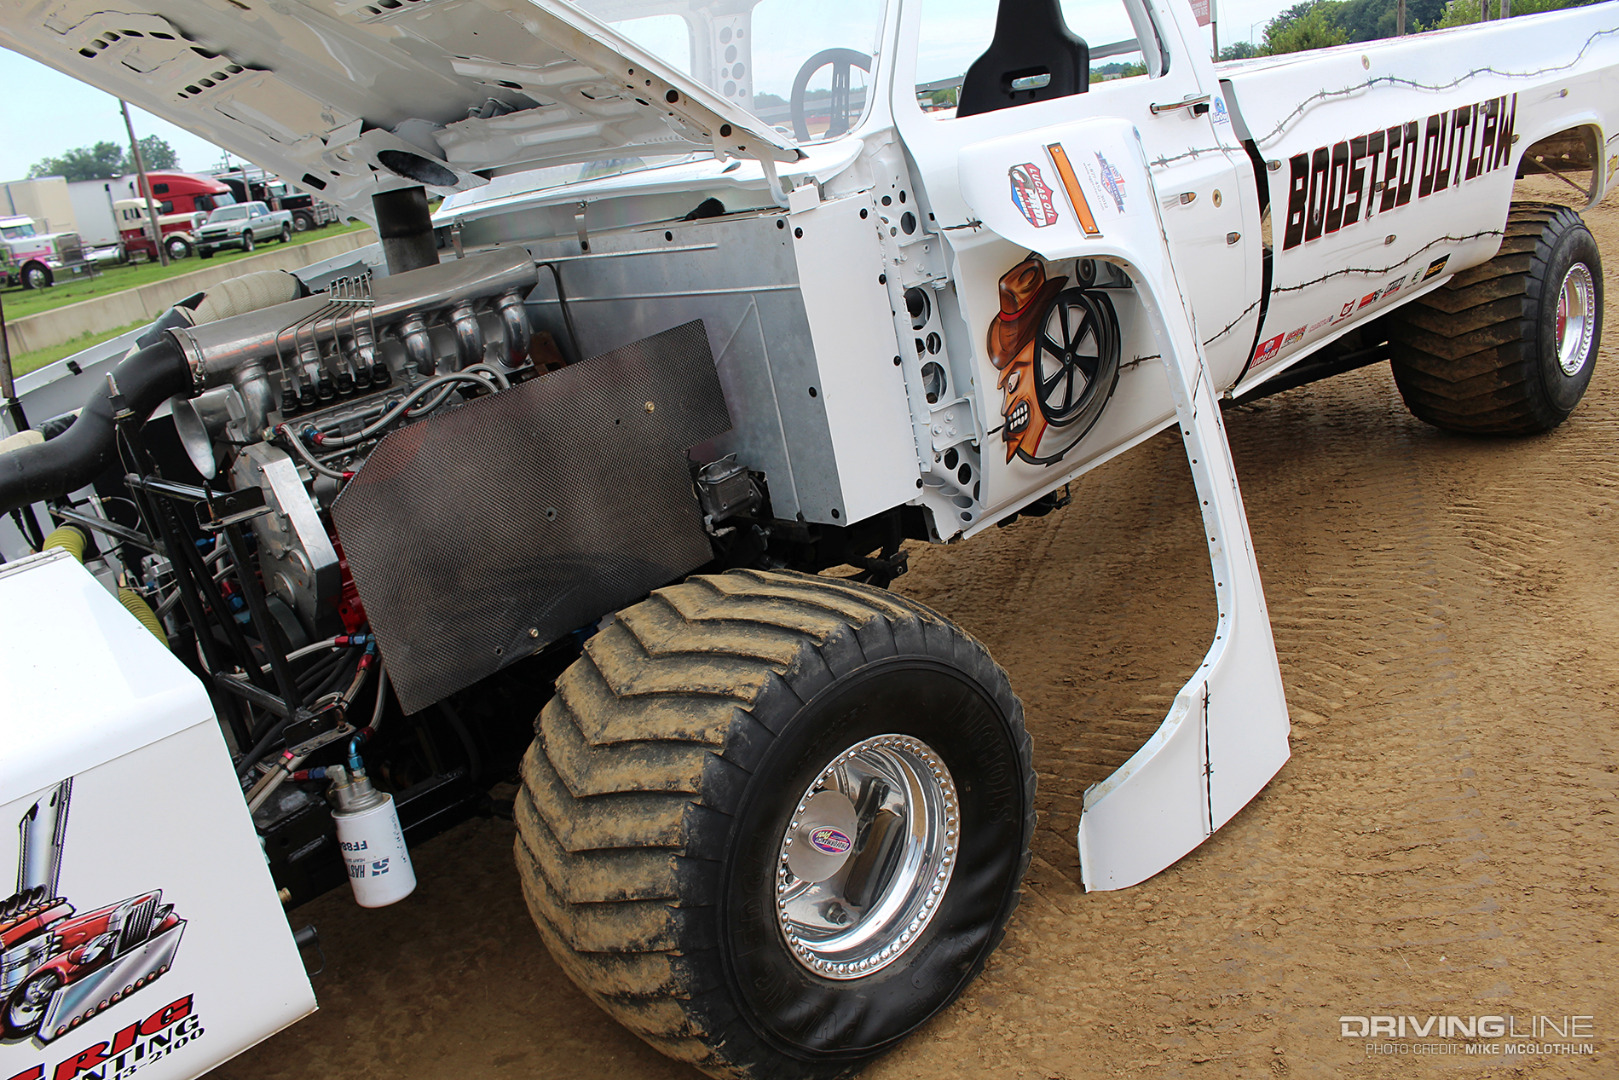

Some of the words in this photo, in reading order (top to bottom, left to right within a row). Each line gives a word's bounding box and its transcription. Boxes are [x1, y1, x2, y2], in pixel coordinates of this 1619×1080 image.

[1029, 166, 1049, 201] LUCAS
[1042, 202, 1056, 219] OIL
[1283, 120, 1418, 251] BOOSTED
[1418, 92, 1517, 199] OUTLAW
[340, 840, 369, 851] FF88
[52, 993, 194, 1080] RIG
